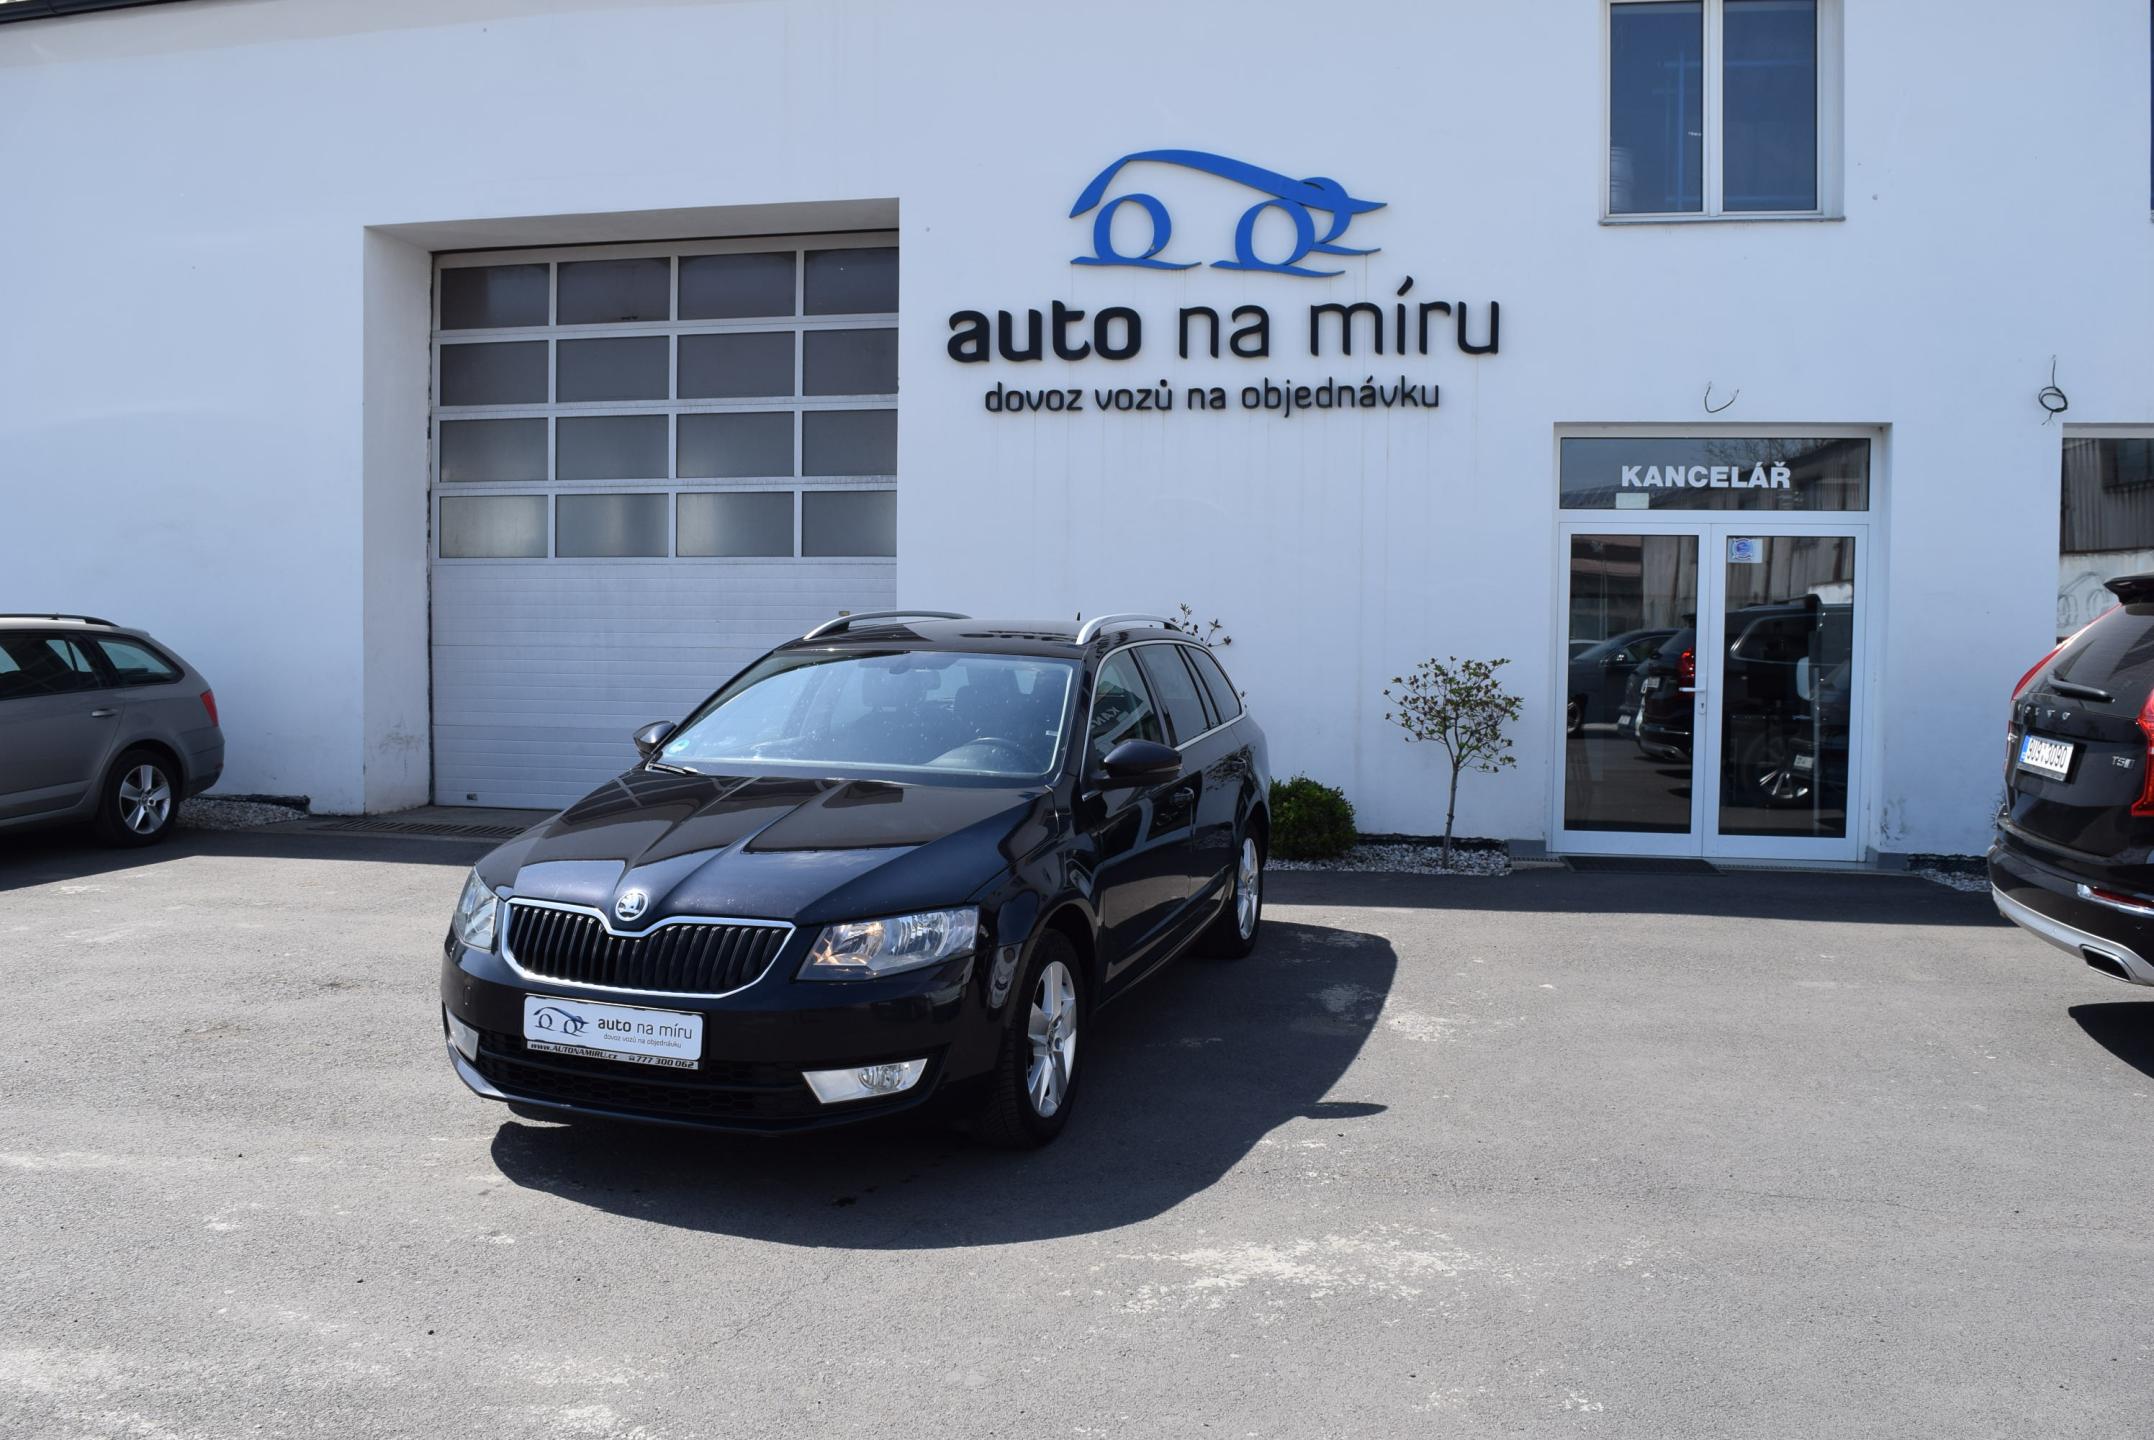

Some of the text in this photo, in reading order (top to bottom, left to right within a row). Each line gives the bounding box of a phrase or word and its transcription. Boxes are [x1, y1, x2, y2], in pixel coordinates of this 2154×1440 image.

[947, 275, 1500, 364] auto na míru
[984, 374, 1440, 419] dovoz vozů na objednávku
[1621, 461, 1791, 489] KANCELÁŘ
[597, 1018, 693, 1040] auto na míru
[603, 1033, 621, 1041] dovoz
[637, 1037, 646, 1045] na
[647, 1037, 682, 1049] objednávku
[655, 1057, 674, 1066] 300
[674, 1060, 695, 1069] 062
